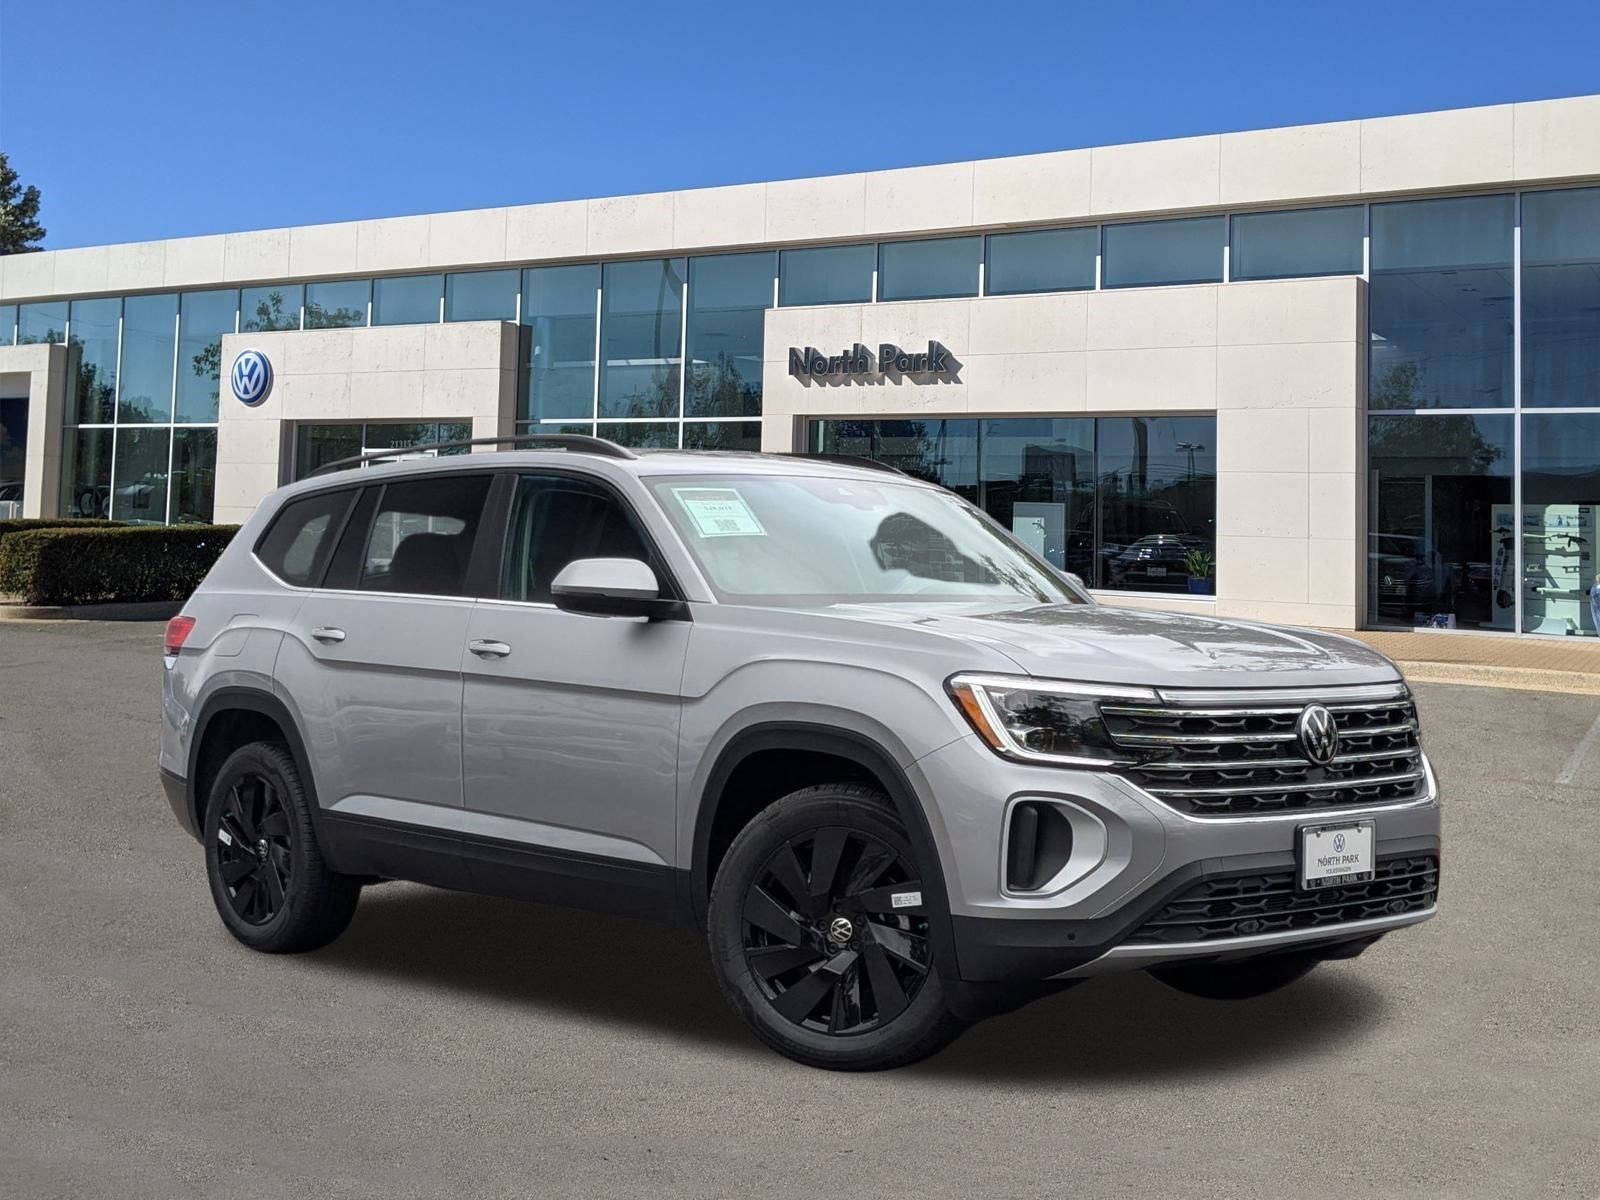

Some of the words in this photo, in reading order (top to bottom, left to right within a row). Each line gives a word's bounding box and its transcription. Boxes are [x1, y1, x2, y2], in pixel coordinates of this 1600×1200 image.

[788, 342, 872, 376] North
[878, 340, 947, 374] Park
[231, 350, 270, 404] VW
[1317, 855, 1341, 868] NORTH
[1341, 854, 1360, 865] PARK
